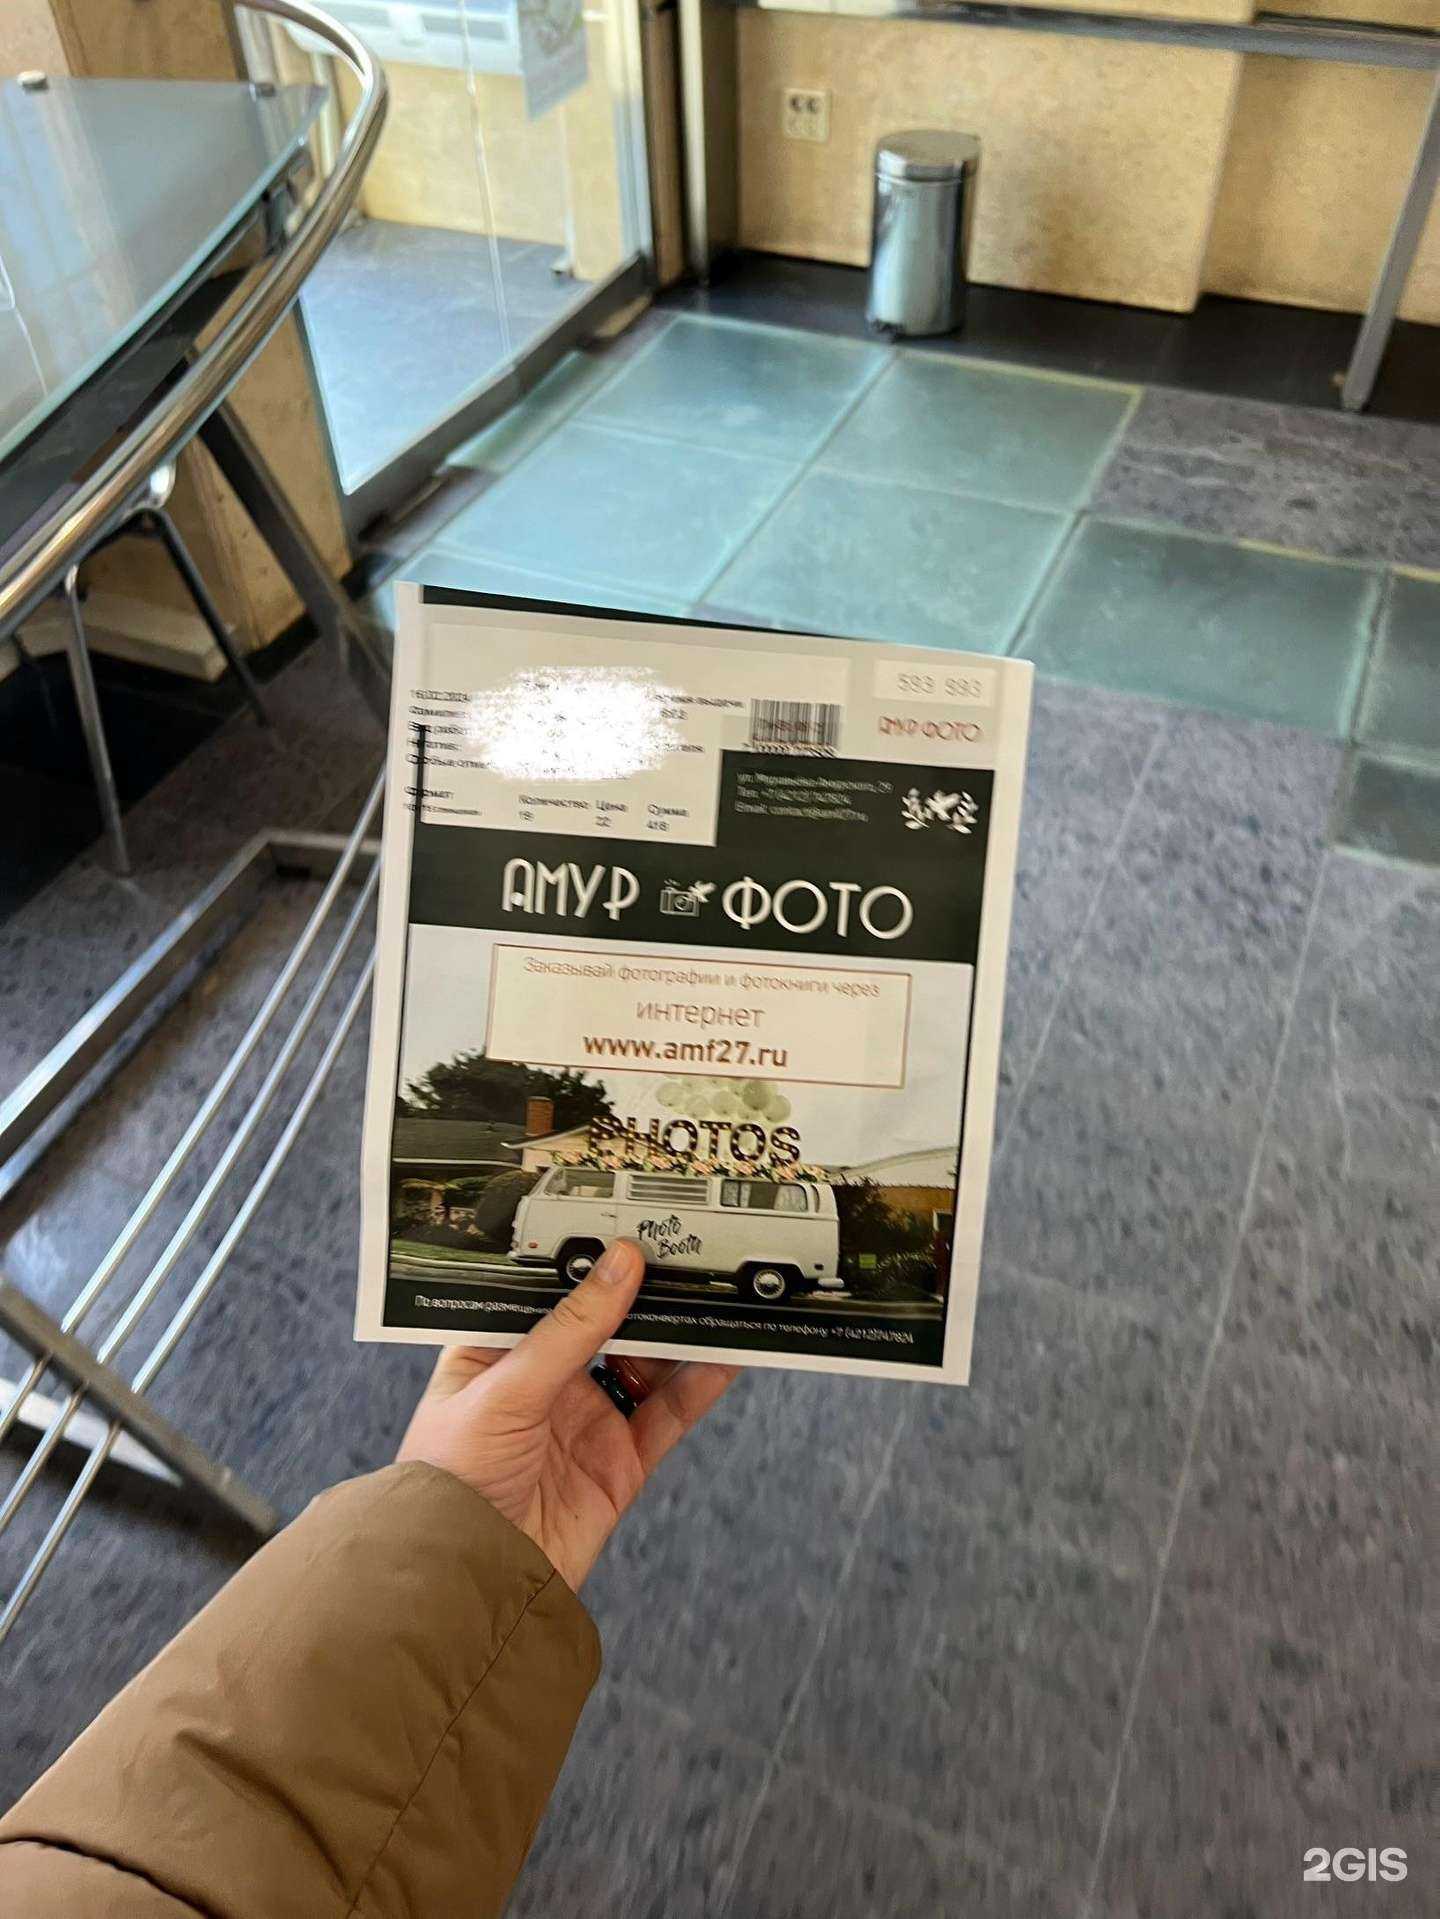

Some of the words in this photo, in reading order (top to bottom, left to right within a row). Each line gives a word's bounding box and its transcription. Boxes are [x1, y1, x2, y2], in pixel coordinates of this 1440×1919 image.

[921, 719, 985, 743] ФОТО
[501, 857, 641, 921] АМУР
[721, 876, 915, 940] ФОТО
[522, 955, 613, 979] Заказывай
[616, 963, 721, 990] фотографии
[724, 974, 737, 987] и
[739, 972, 830, 997] фотокниги
[832, 982, 881, 1000] через
[636, 1000, 765, 1030] интернет
[583, 1034, 788, 1068] www.amf27.ru
[588, 1114, 801, 1167] PHOTOS
